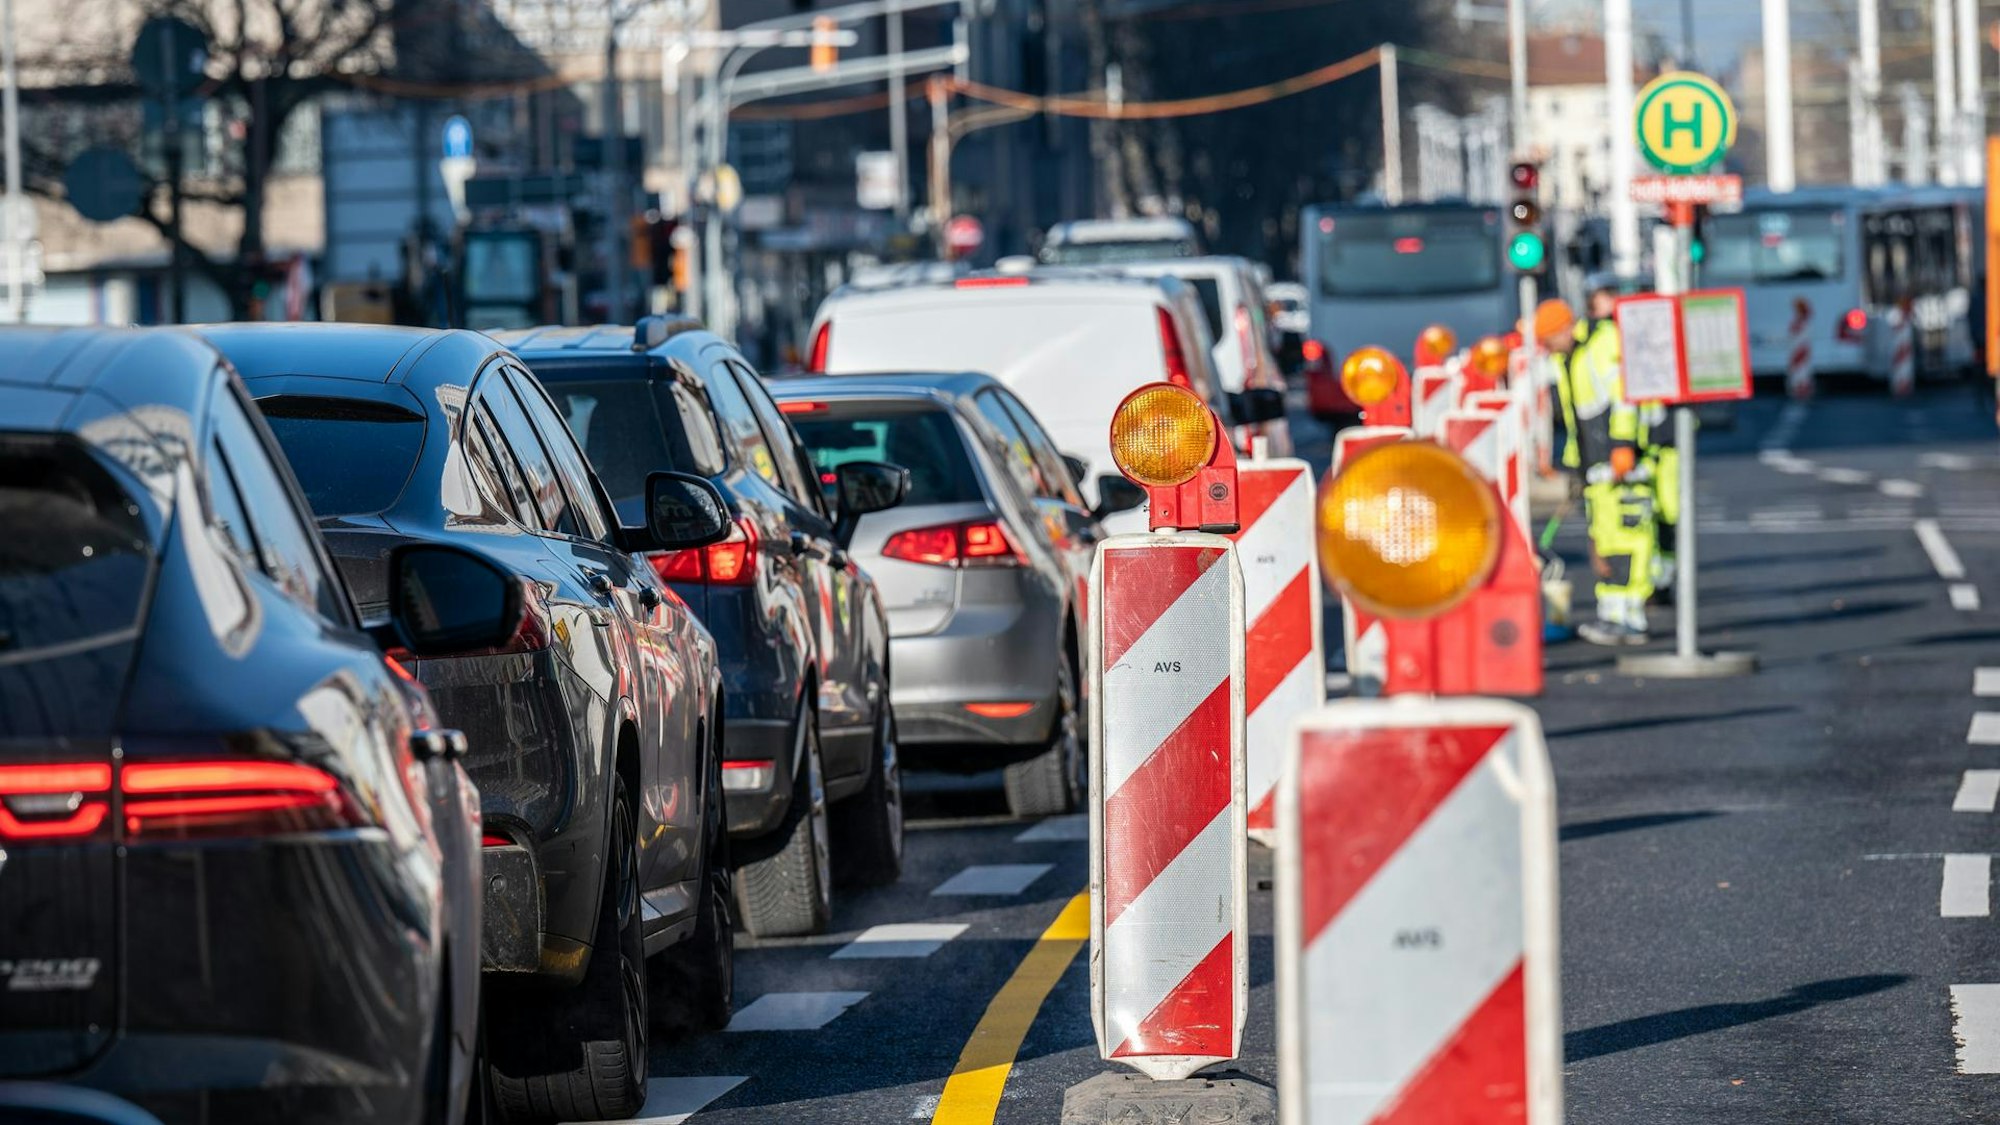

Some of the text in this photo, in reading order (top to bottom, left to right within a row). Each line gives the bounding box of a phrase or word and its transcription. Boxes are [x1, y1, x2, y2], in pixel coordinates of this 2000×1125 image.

[1663, 102, 1702, 149] H
[1153, 661, 1181, 673] AVS
[1393, 927, 1443, 950] AVS
